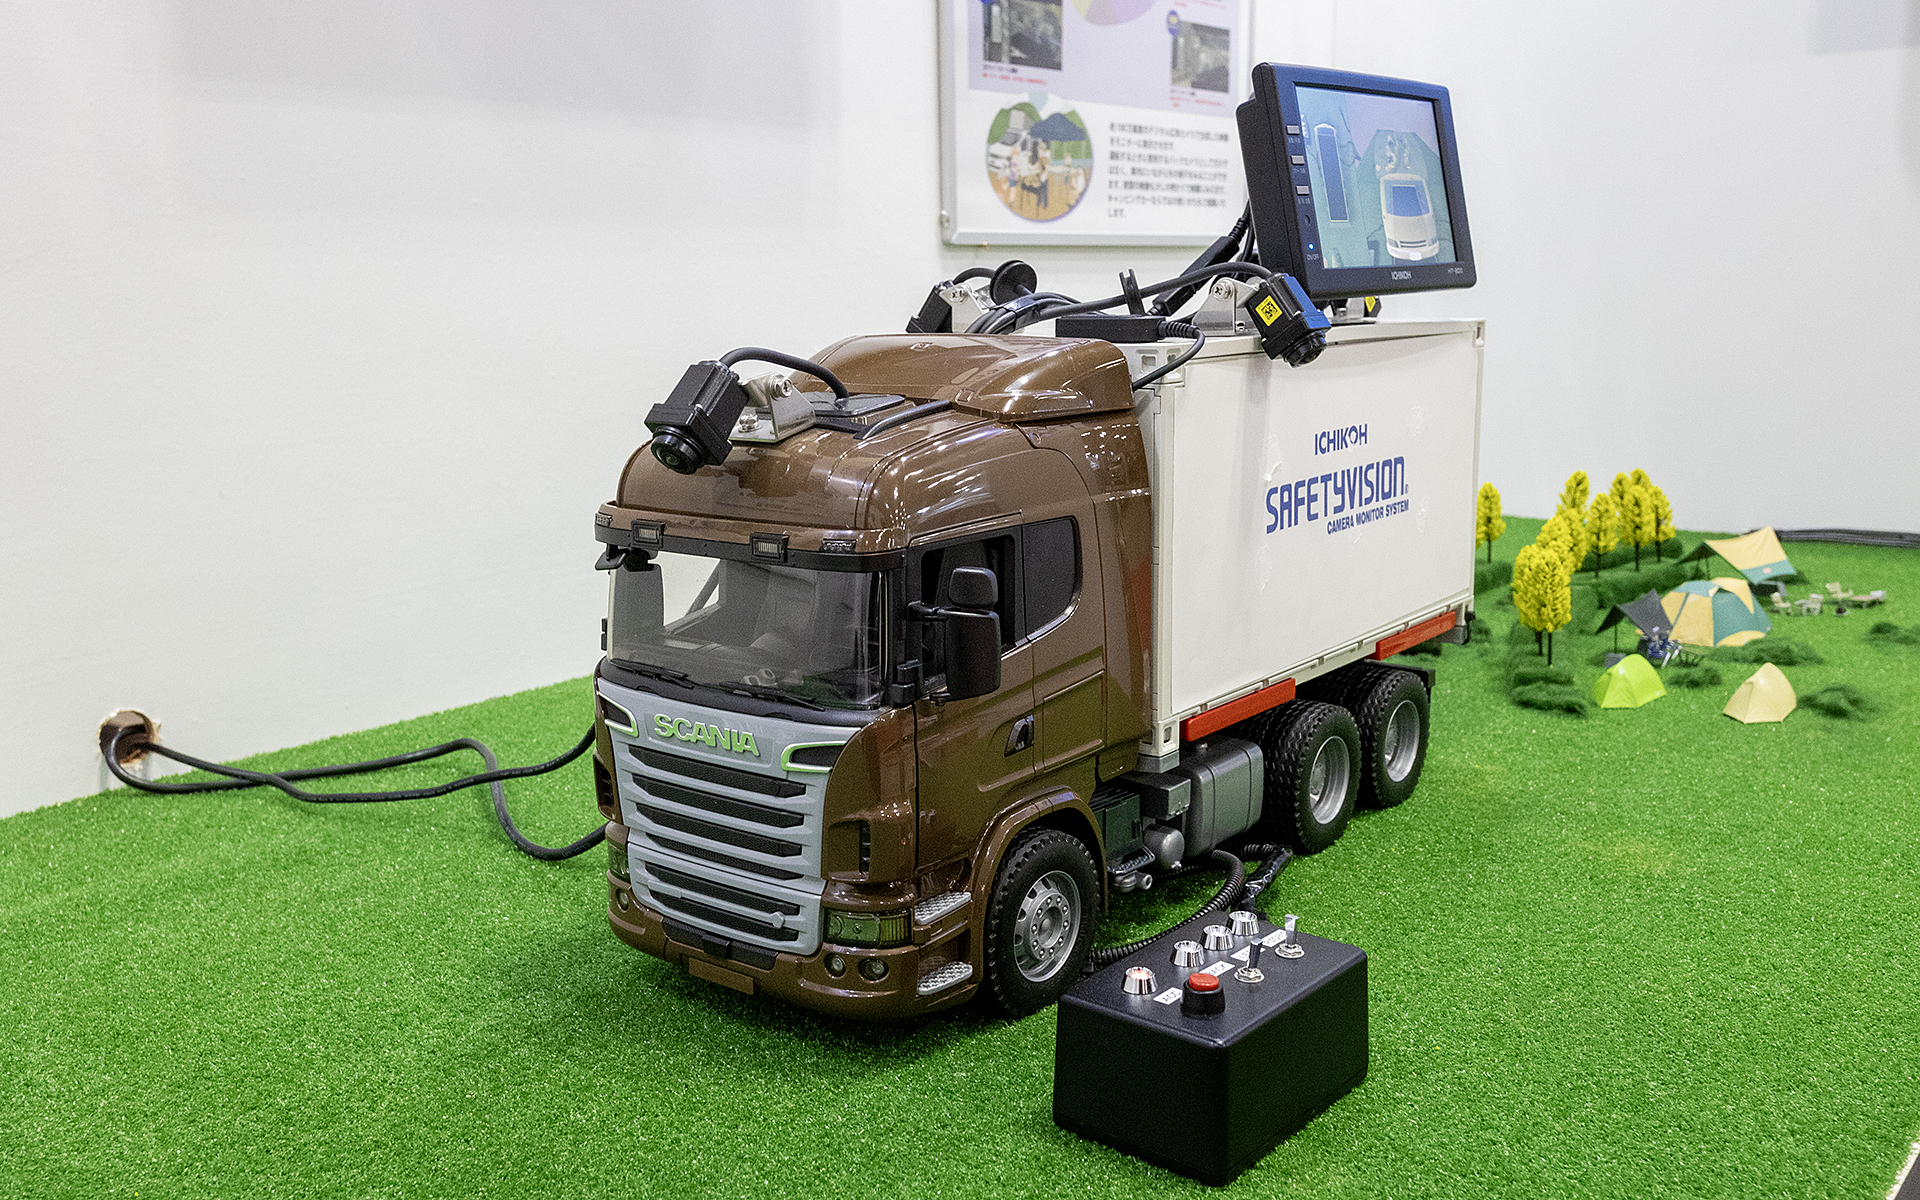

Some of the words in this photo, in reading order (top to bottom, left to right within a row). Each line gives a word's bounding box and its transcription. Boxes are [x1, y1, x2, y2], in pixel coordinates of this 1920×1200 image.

[1314, 423, 1368, 456] ICHIKOH
[1326, 516, 1355, 535] CAMERA
[1355, 506, 1385, 526] MONITOR
[1385, 499, 1410, 518] SYSTEM
[653, 713, 760, 757] SCANIA
